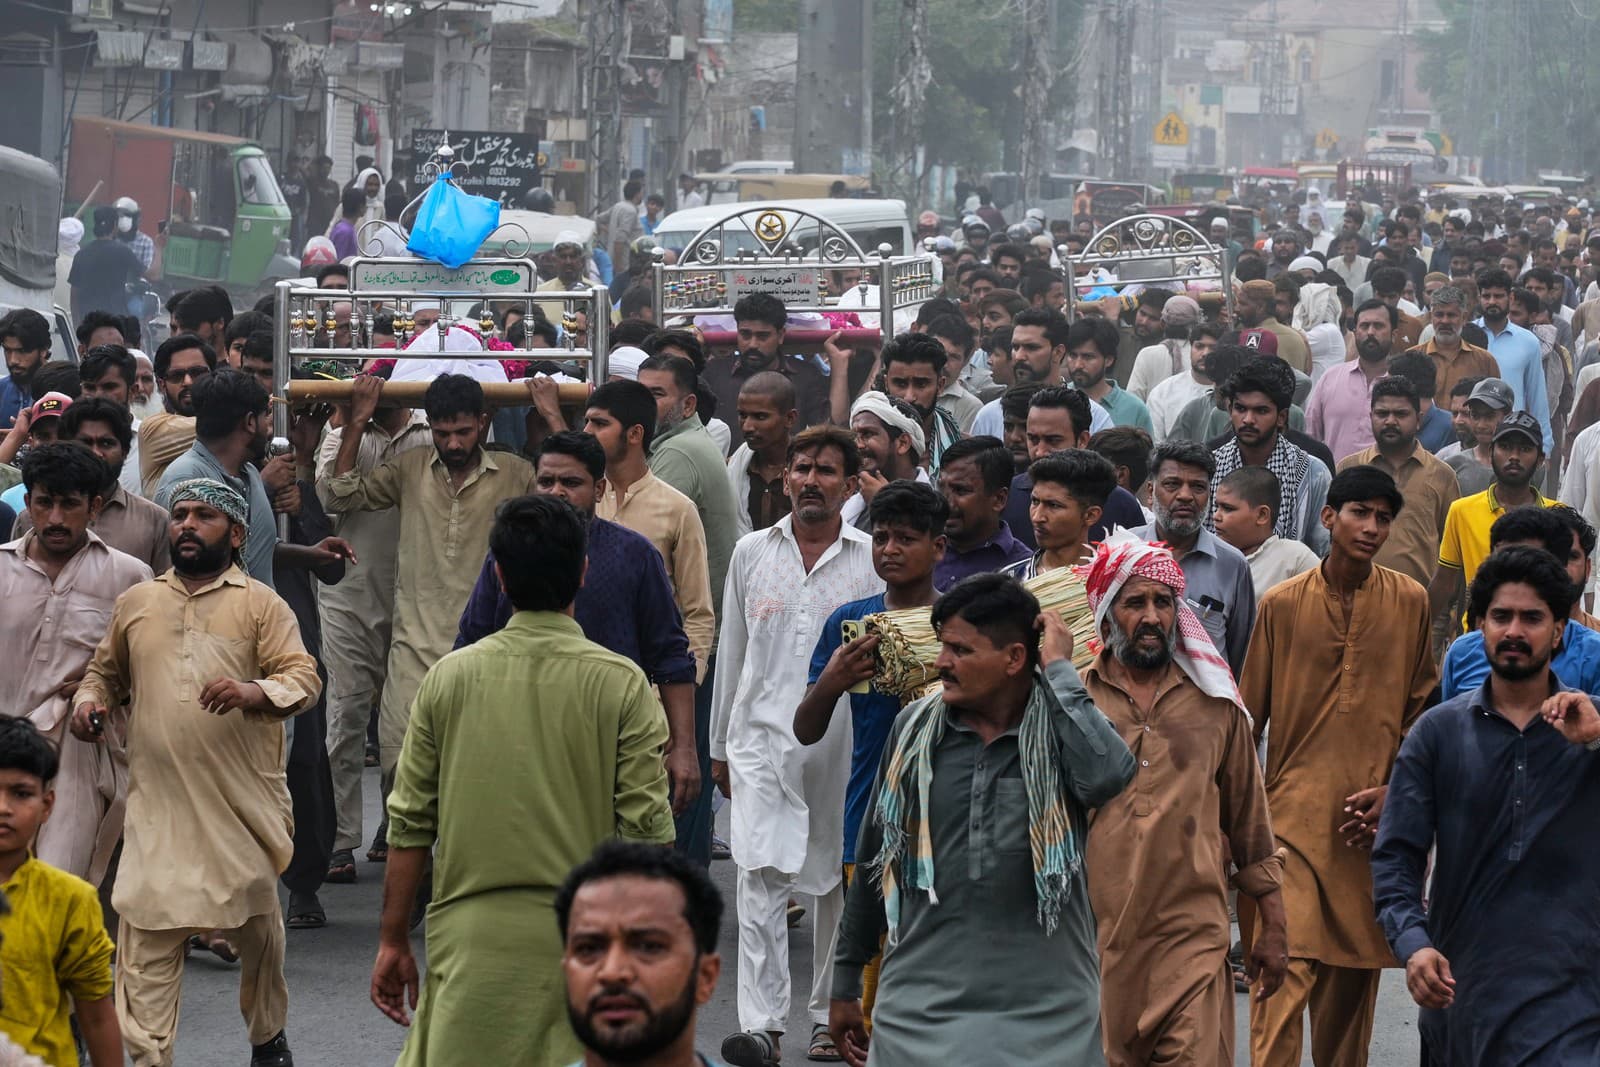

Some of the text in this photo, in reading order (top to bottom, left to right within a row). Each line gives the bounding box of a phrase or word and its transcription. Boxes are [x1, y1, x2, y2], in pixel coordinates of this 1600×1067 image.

[461, 136, 504, 166] عقیل
[490, 137, 512, 166] محمد
[748, 274, 775, 285] سواری
[775, 272, 796, 285] آخری
[1246, 336, 1257, 347] A
